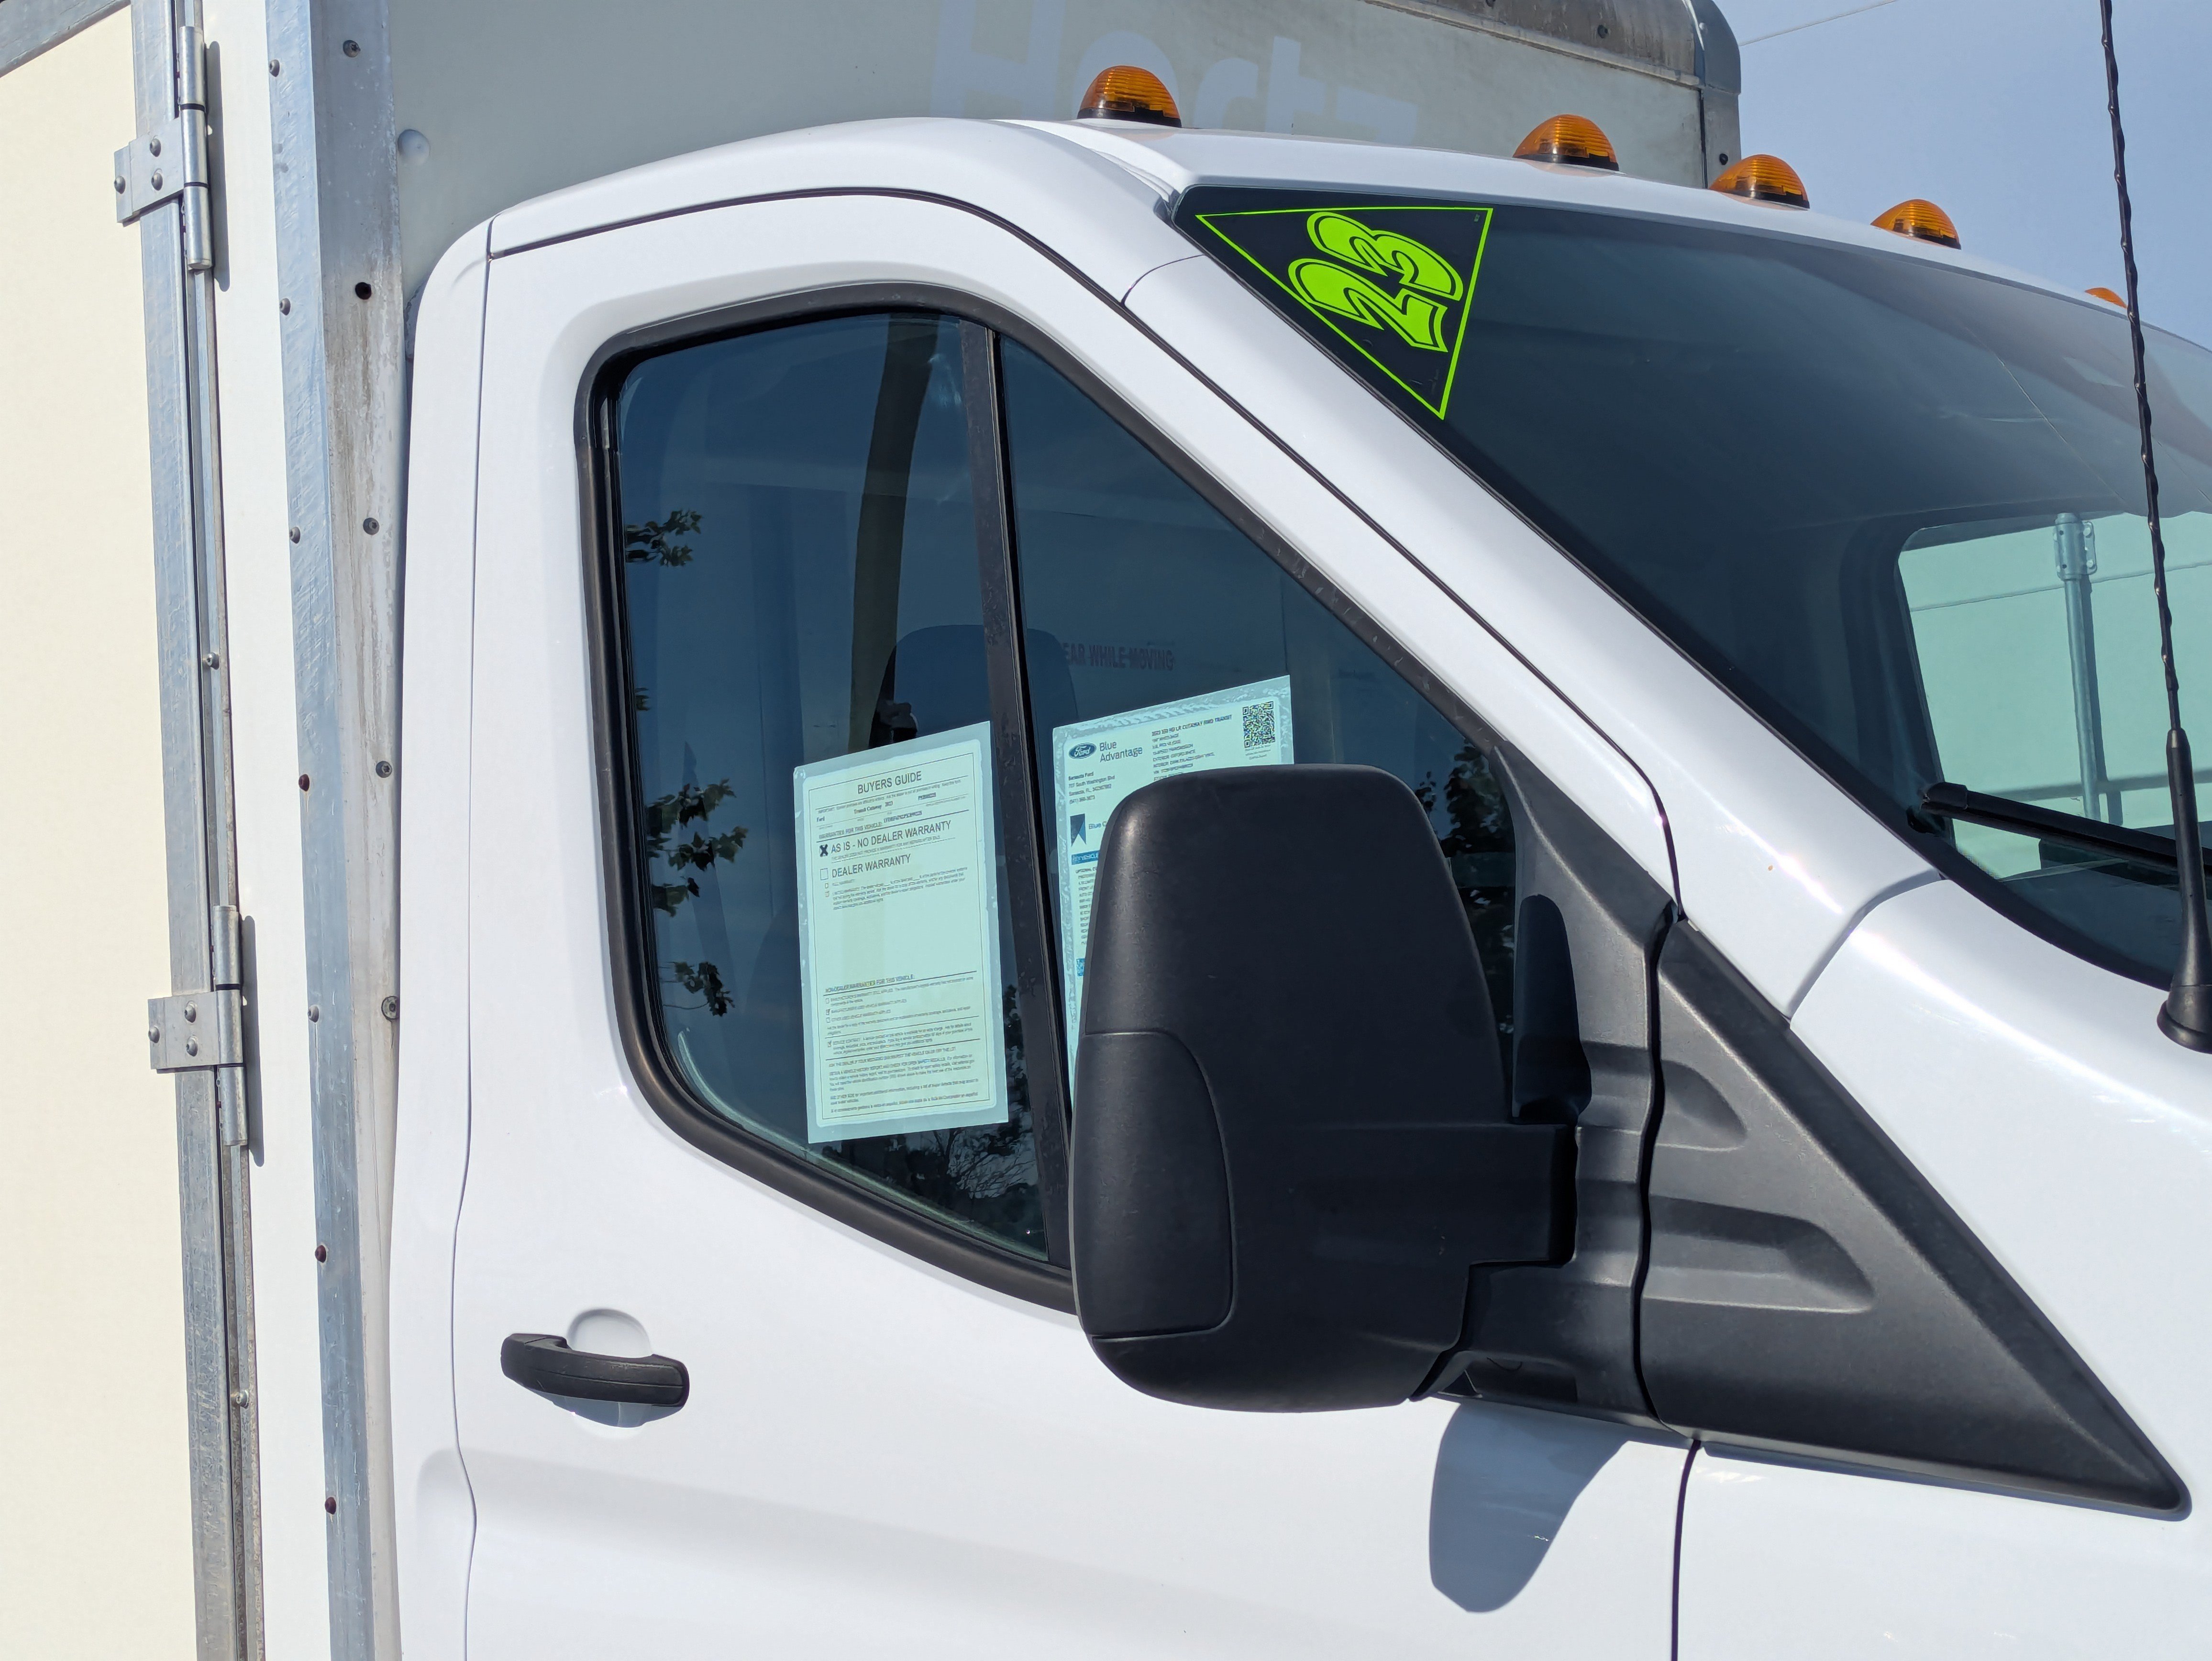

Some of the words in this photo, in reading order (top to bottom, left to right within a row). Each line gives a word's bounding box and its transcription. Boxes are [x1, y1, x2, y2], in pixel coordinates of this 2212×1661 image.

[1288, 212, 1463, 353] 23
[1100, 741, 1117, 752] Blue
[1100, 747, 1143, 763] Advantage
[857, 778, 892, 794] BUYERS
[895, 771, 922, 786] GUIDE
[831, 843, 841, 853] AS
[843, 841, 851, 851] IS
[857, 837, 869, 848] NO
[871, 830, 903, 846] DEALER
[905, 820, 951, 839] WARRANTY
[832, 863, 863, 878] DEALER
[865, 853, 911, 872] WARRANTY
